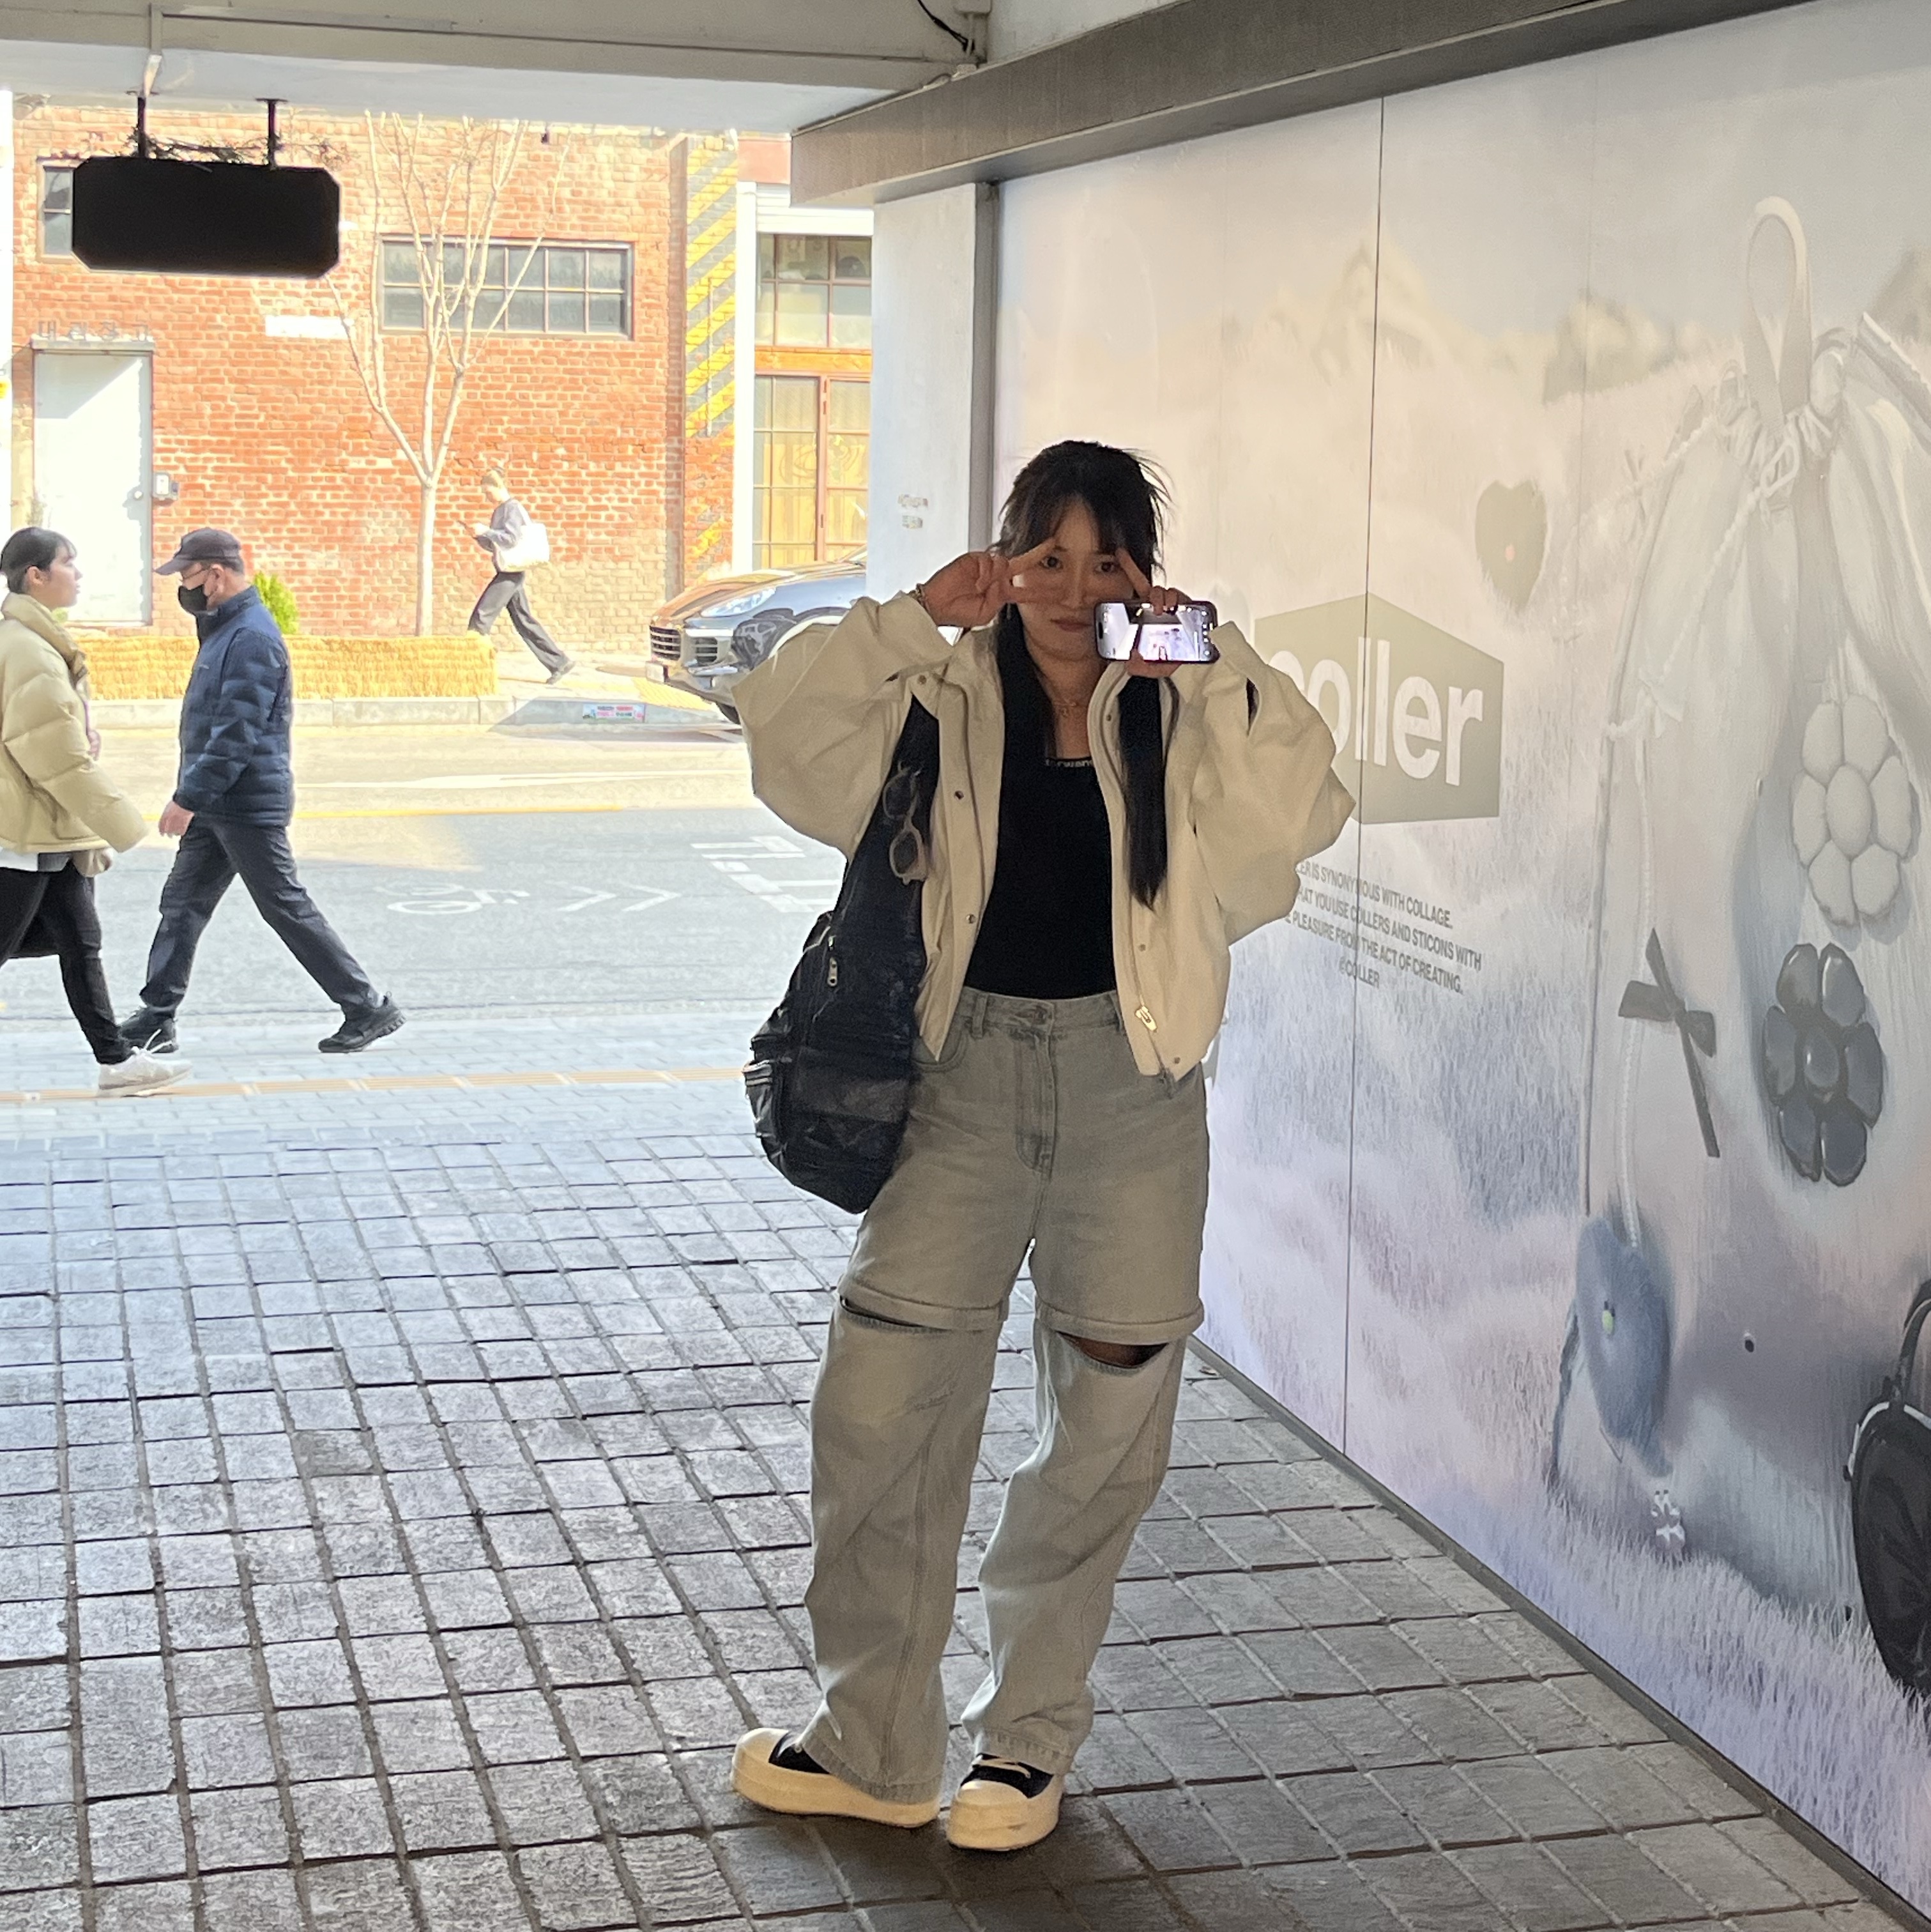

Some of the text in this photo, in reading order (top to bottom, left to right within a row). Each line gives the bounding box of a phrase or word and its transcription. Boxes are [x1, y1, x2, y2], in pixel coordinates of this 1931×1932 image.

[1312, 862, 1320, 880] IS
[1382, 887, 1405, 911] WITH
[1406, 896, 1453, 929] COLLAGE.
[1315, 891, 1332, 912] YOU
[1332, 898, 1349, 919] USE
[1350, 905, 1391, 935] COLLERS
[1391, 921, 1411, 942] AND
[1412, 928, 1454, 960] STICONS
[1455, 944, 1482, 972] WITH
[1292, 910, 1334, 941] PLEASURE
[1335, 927, 1359, 951] FROM
[1361, 937, 1378, 959] THE
[1379, 945, 1398, 967] ACT
[1399, 953, 1412, 972] OF
[1412, 958, 1463, 995] CREATING.
